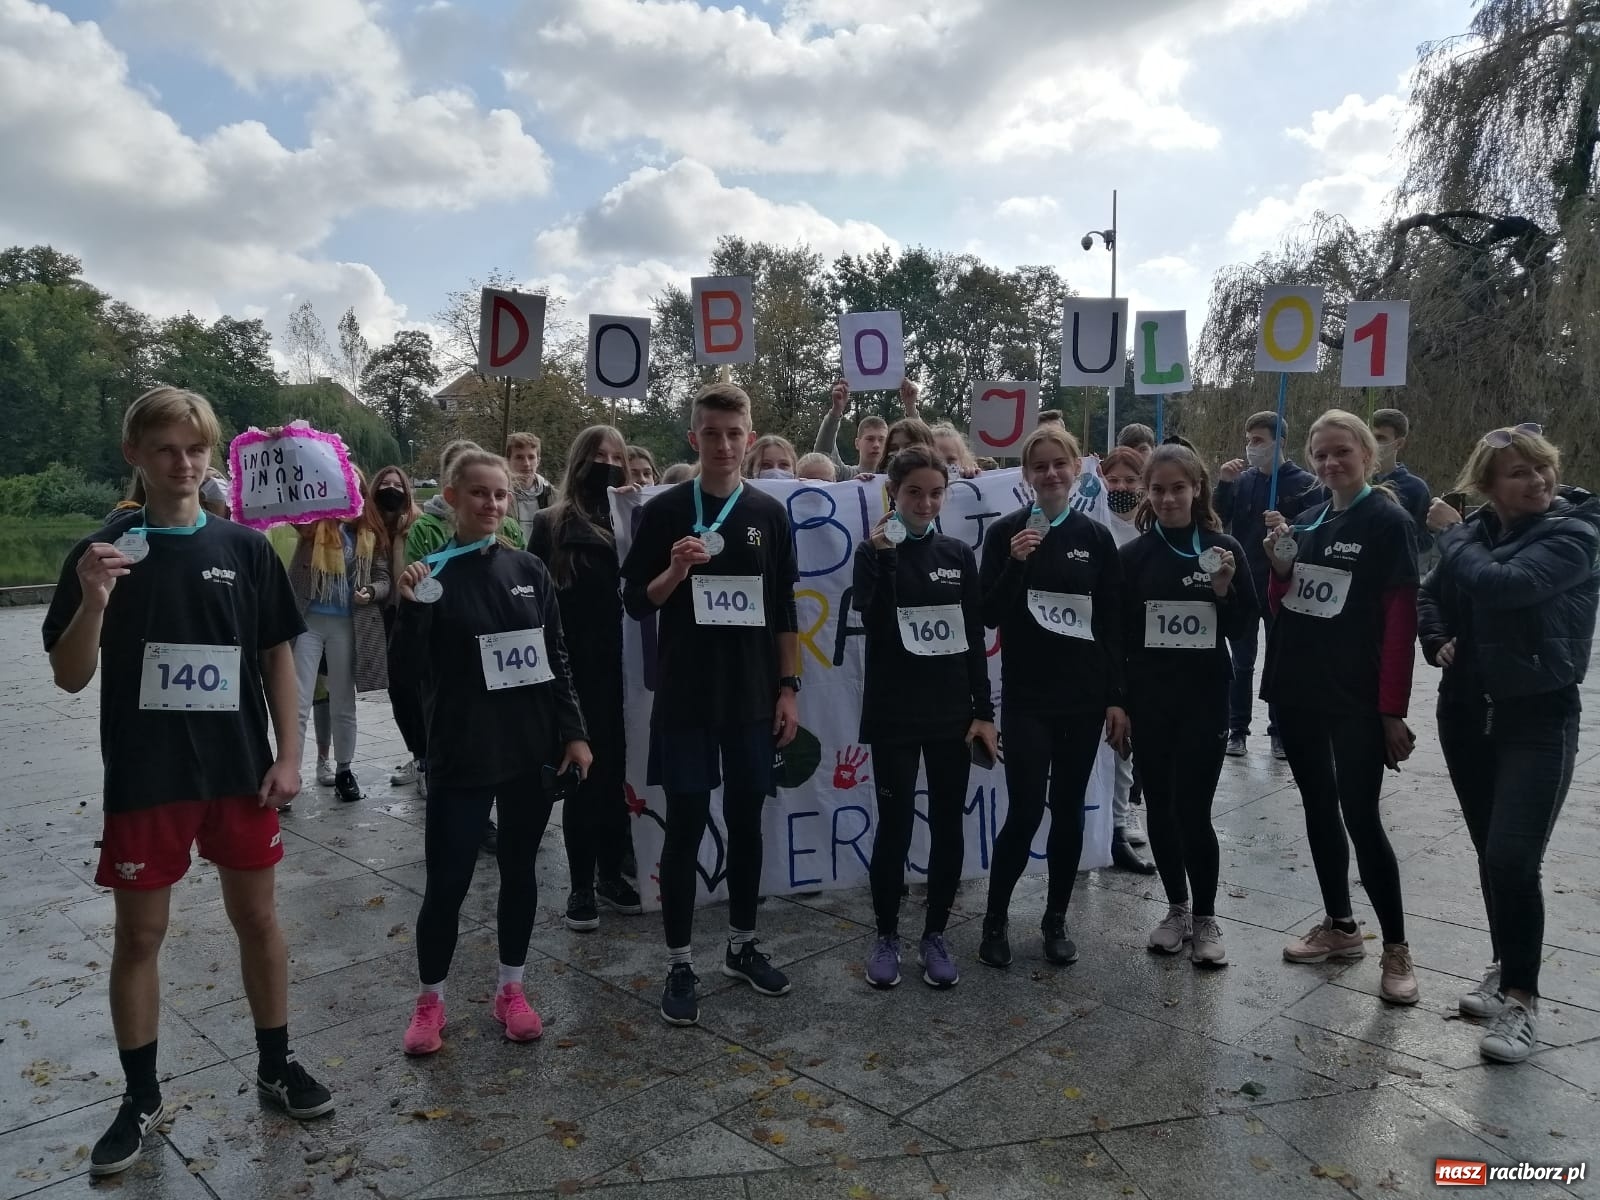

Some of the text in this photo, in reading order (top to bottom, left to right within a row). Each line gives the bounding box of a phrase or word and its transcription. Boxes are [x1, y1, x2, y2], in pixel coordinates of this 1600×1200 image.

[244, 447, 284, 470] RUN!
[251, 465, 303, 492] RUN!
[277, 481, 327, 503] RUN!
